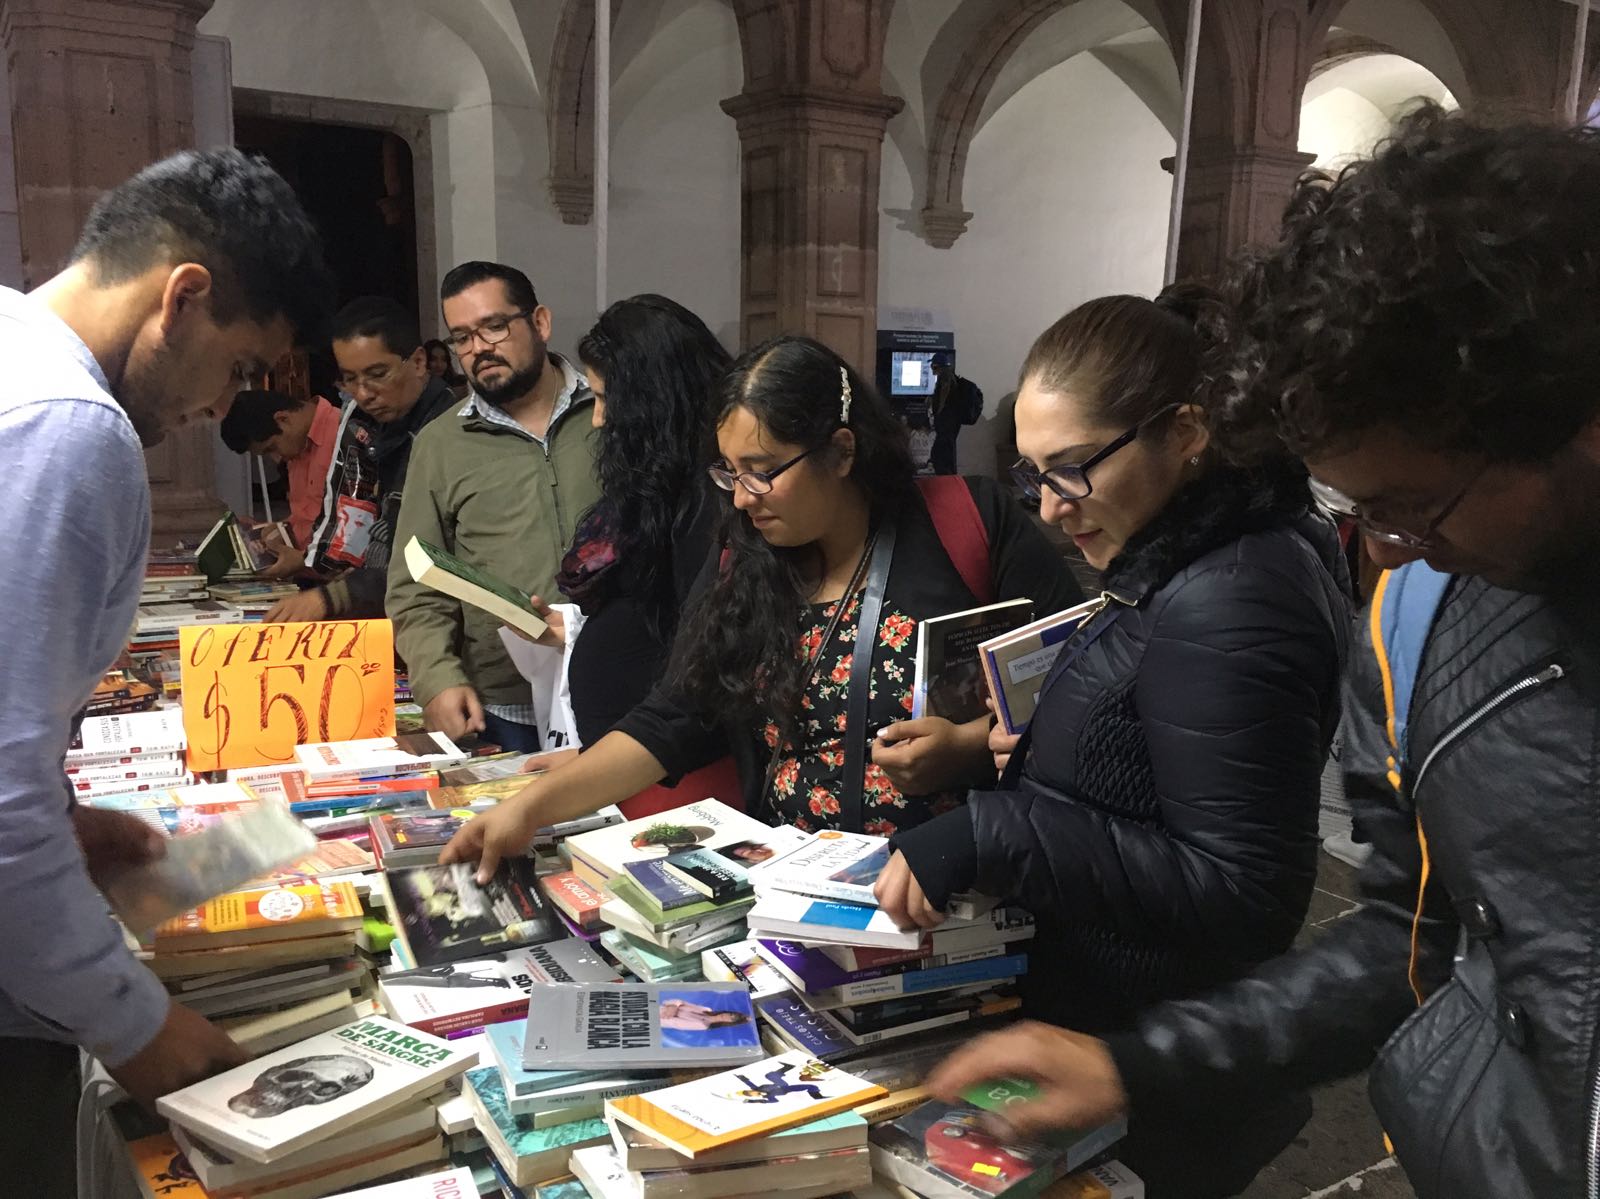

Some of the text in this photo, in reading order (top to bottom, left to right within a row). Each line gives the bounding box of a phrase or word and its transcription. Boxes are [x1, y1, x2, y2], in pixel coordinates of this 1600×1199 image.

[563, 883, 590, 899] amor
[587, 991, 621, 1050] MAGIA BLANCA
[622, 991, 657, 1049] AYÚDATE CON LA
[775, 1008, 823, 1046] CARLOS TREJO
[336, 1029, 438, 1068] DE SANGRE
[350, 1020, 454, 1062] MARCA
[431, 1177, 462, 1199] RIC
